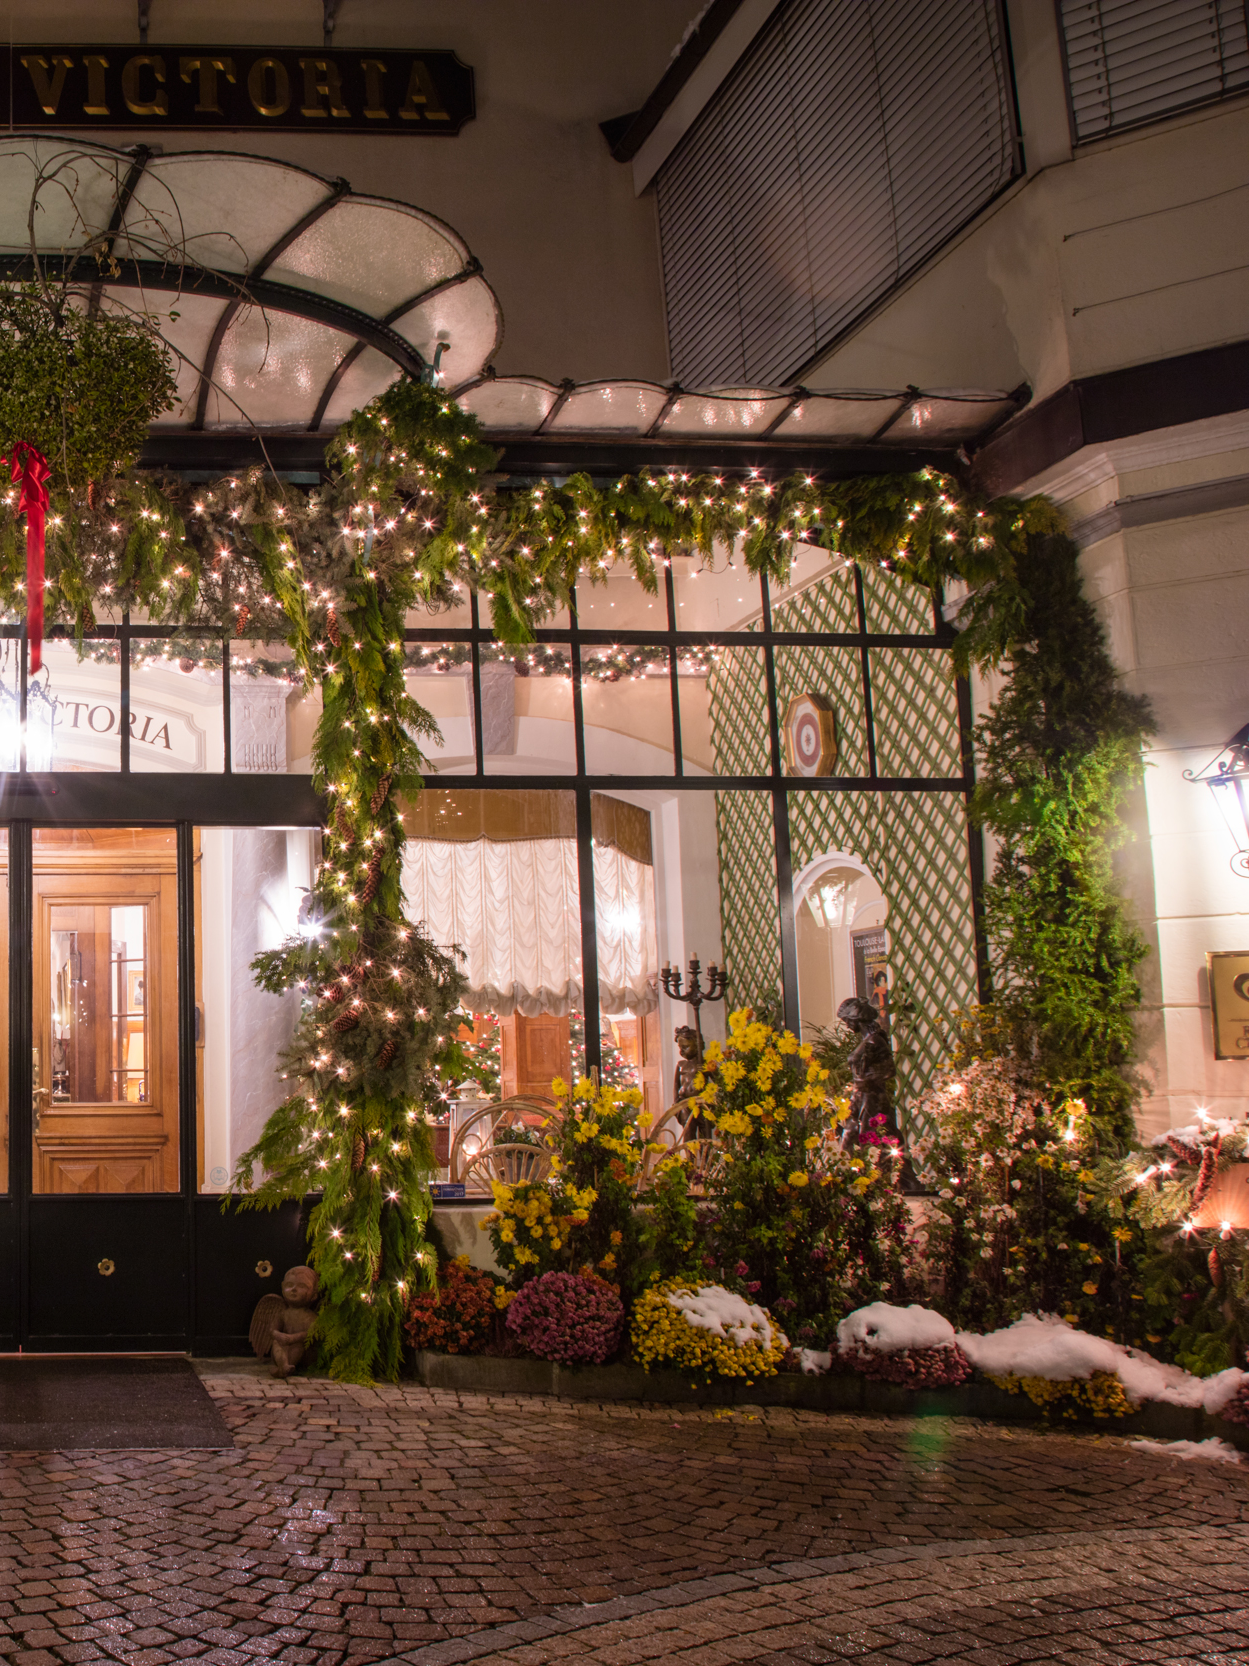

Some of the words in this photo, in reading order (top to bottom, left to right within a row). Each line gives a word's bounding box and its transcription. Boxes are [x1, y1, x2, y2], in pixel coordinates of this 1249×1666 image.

[20, 54, 451, 121] VICTORIA
[34, 700, 173, 751] CTORIA
[854, 936, 885, 948] TOULOUSE-LA
